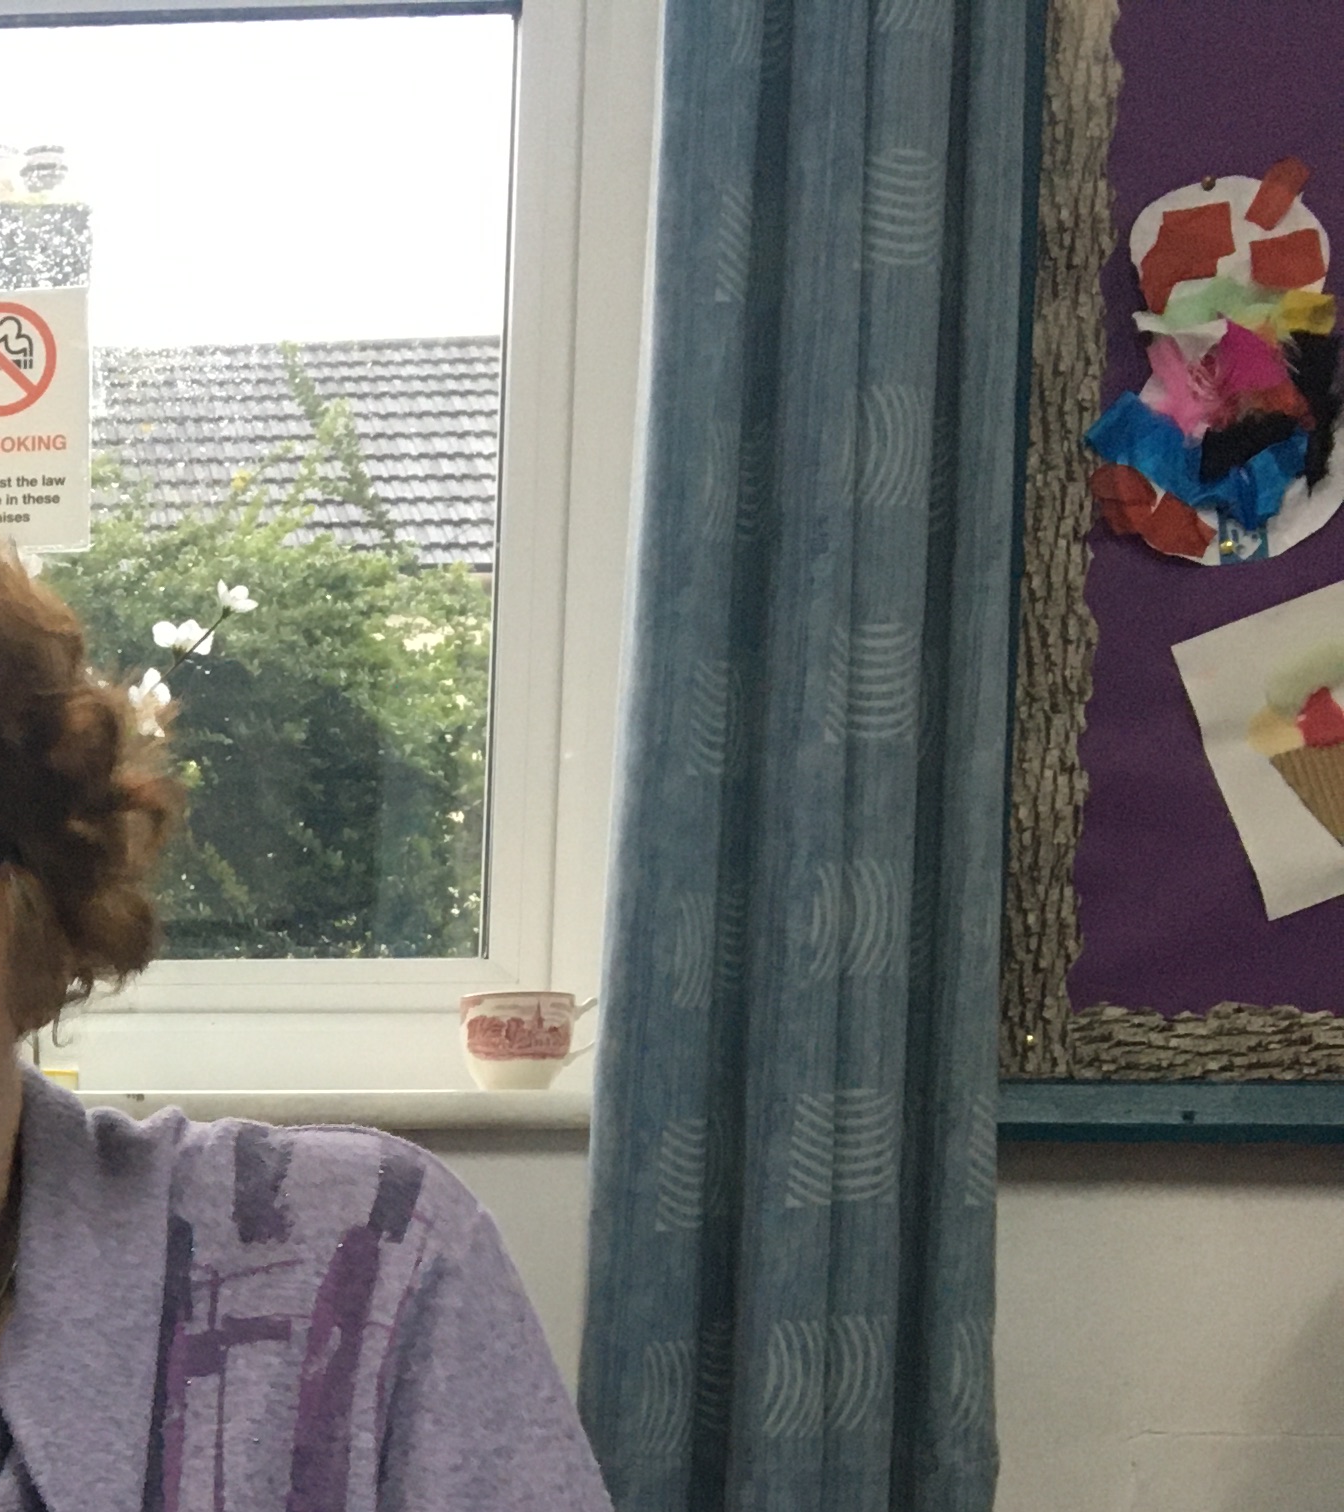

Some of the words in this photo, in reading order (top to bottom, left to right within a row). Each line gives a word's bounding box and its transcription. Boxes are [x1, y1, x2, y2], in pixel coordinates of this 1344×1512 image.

[16, 476, 38, 487] the
[42, 475, 66, 486] law
[6, 494, 18, 505] in
[22, 493, 60, 505] these
